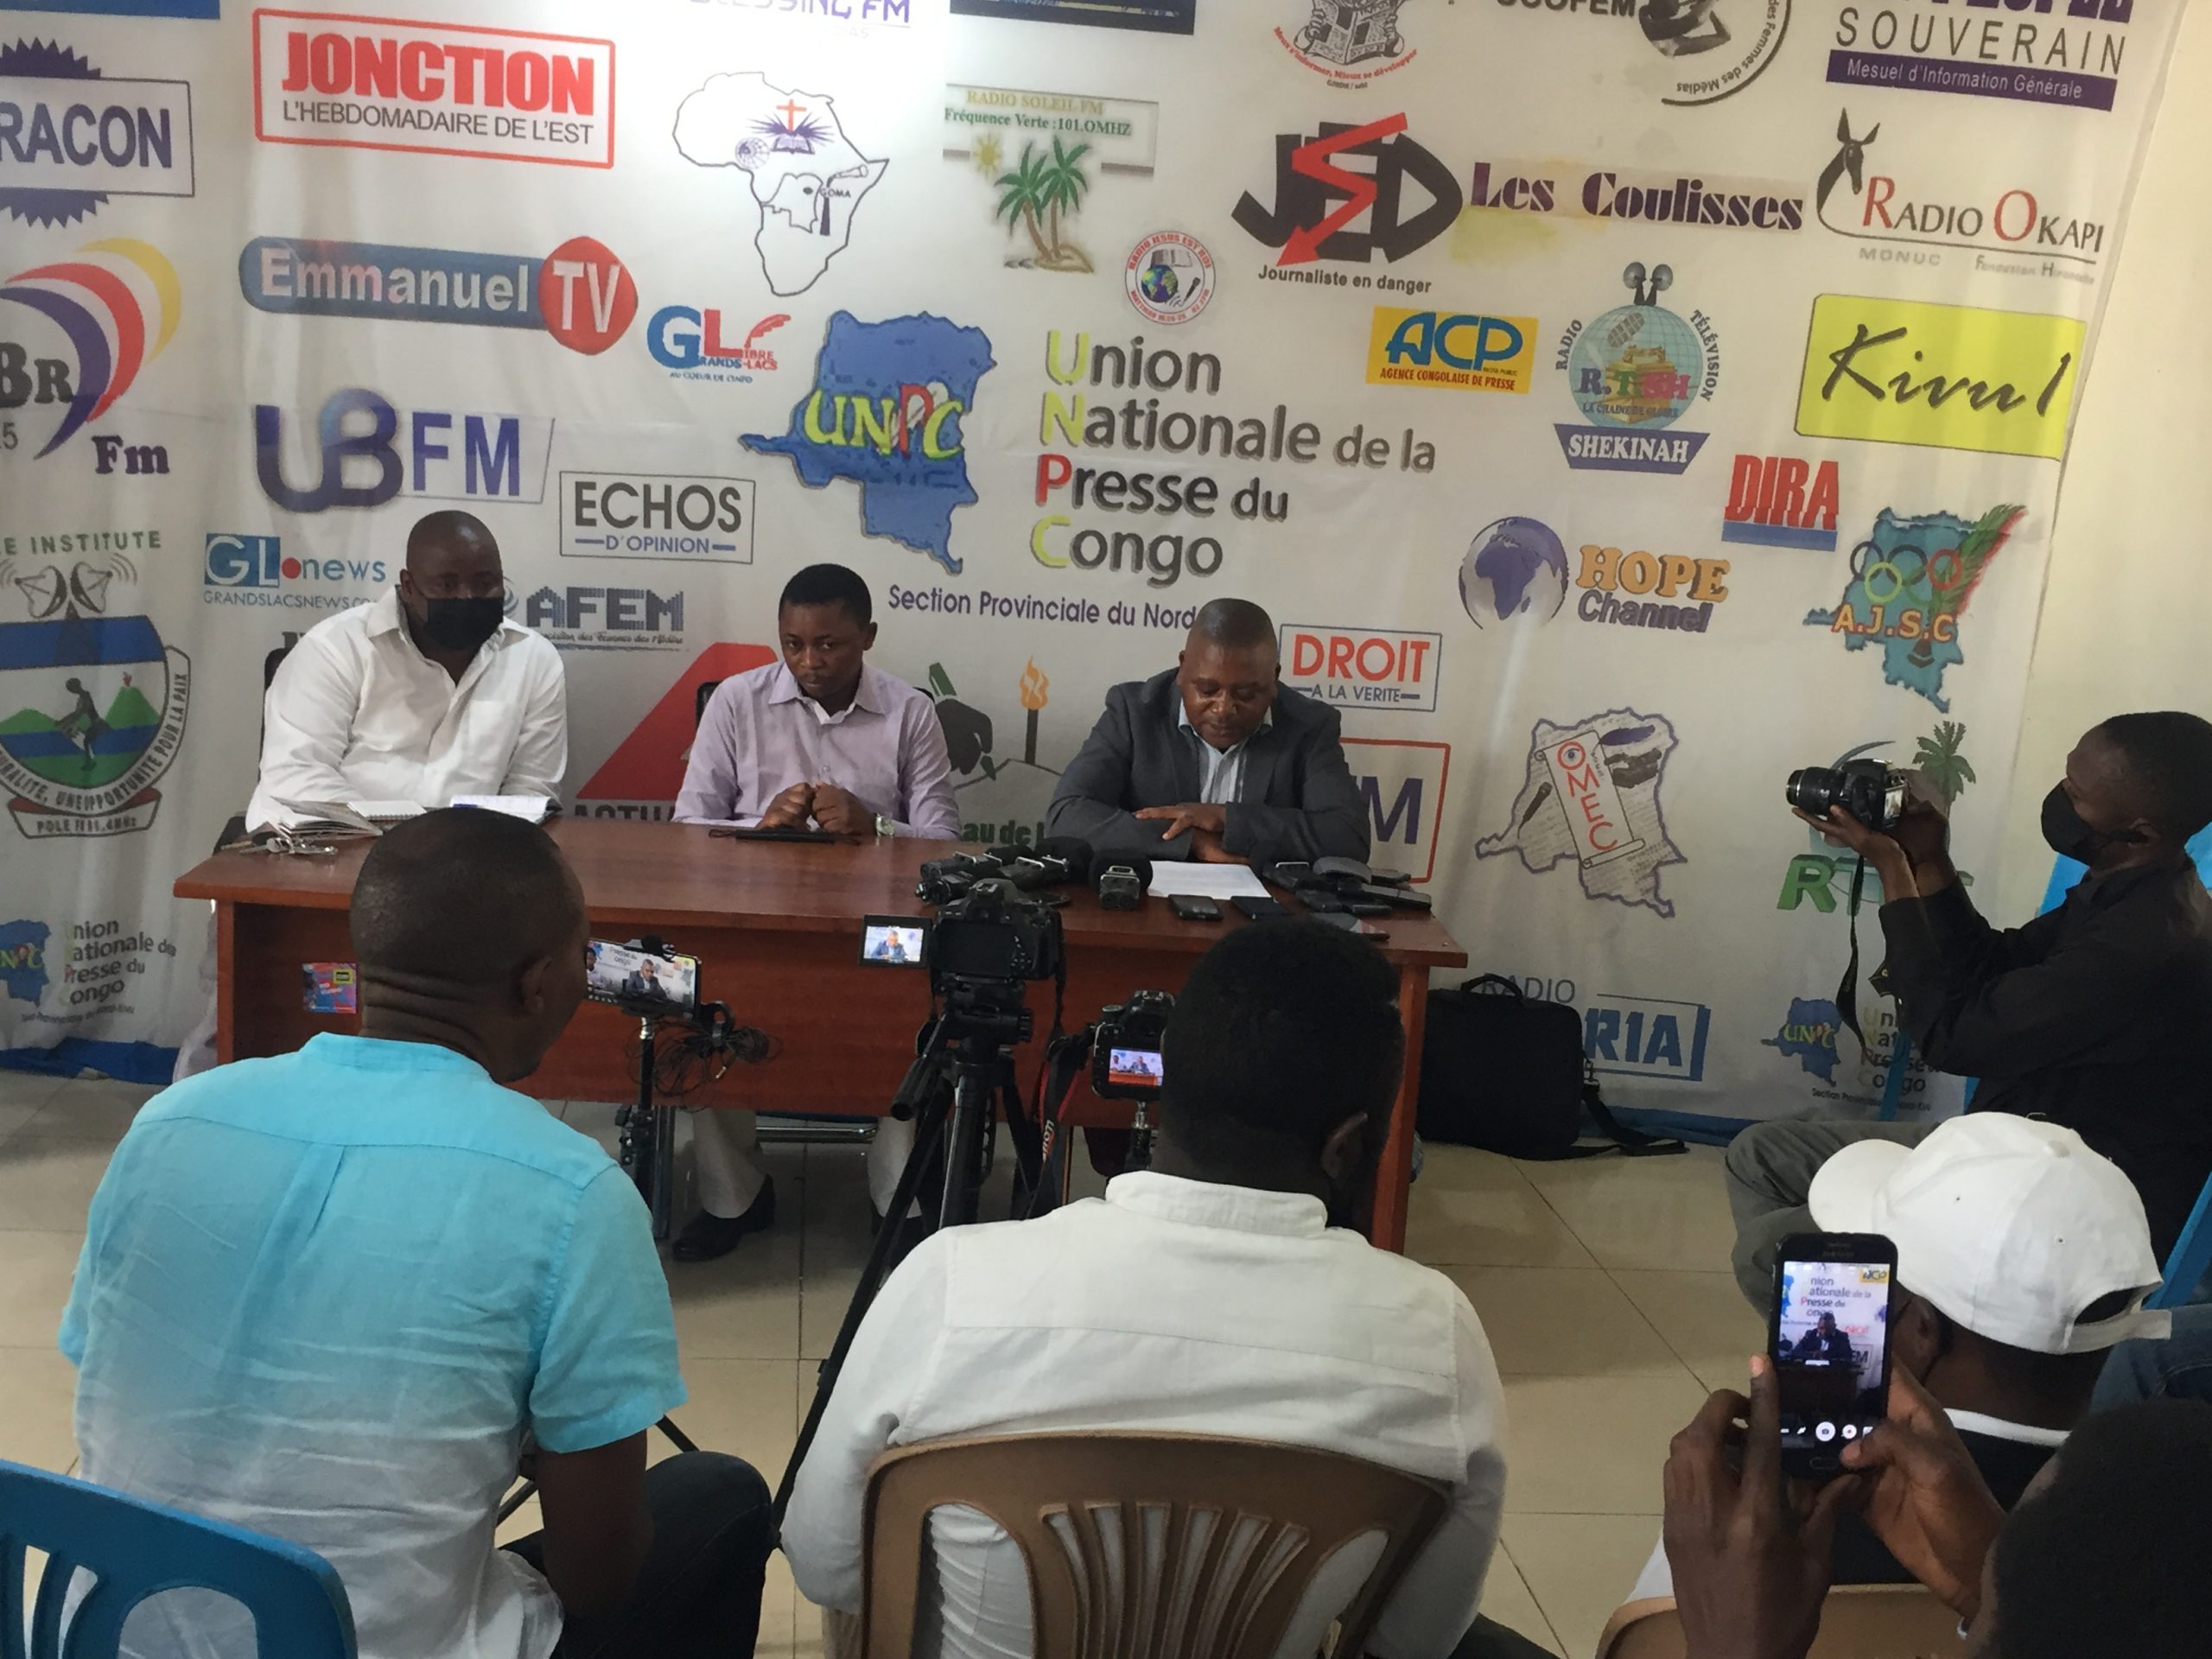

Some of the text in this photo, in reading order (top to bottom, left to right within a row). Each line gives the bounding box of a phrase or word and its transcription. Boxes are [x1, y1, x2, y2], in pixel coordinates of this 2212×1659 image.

[1741, 22, 1777, 68] Femmes
[1835, 7, 2126, 76] SOUVERAIN
[282, 32, 595, 116] JONCTION
[1676, 77, 1719, 95] Médias
[1721, 67, 1742, 84] des
[1847, 58, 2082, 99] Mesuel d'Information Générale
[283, 99, 594, 146] L'HEBDOMADAIRE DE L'EST
[944, 107, 1012, 125] Fréquence
[1014, 113, 1050, 129] Verte
[966, 90, 1104, 115] RADIO SOLEIL FM
[1471, 162, 1804, 231] Les Coulisses
[1861, 175, 2105, 253] RADIO OKAPI
[1258, 264, 1433, 296] Journaliste en danger
[1859, 247, 1942, 266] MONUC
[261, 247, 621, 334] Emmanuel TV
[1046, 329, 1222, 396] Union
[1384, 311, 1523, 372] ACP
[1555, 319, 1583, 371] RADIO
[1689, 308, 1720, 402] TÉLÉVISION
[1380, 367, 1516, 391] AGENCE CONGOLAISE DE PRESSE
[804, 383, 963, 460] UNPC
[1039, 391, 1435, 474] Nationale de la
[92, 435, 170, 474] Fm
[412, 410, 521, 497] FM
[1568, 433, 1689, 464] SHEKINAH
[574, 480, 742, 534] ECHOS
[1034, 452, 1290, 522] Presse du
[1724, 453, 1840, 531] DIRA
[30, 530, 162, 556] INSTITUTE
[605, 535, 710, 555] D'OPINION
[1030, 514, 1224, 588] Congo
[1575, 543, 1732, 602] HOPE
[526, 585, 684, 632] AFEM
[887, 583, 1198, 631] Section Provinciale du Nord
[1577, 588, 1715, 633] Channel
[1829, 603, 1957, 643] A.J.S.C
[1292, 633, 1431, 684] DROIT
[172, 673, 188, 709] PAIX
[1311, 685, 1402, 703] A LA VERITE
[169, 710, 185, 728] LA
[1557, 741, 1618, 851] OMEC
[126, 957, 146, 975] du
[1783, 1021, 1836, 1048] UNPC
[1858, 1067, 1927, 1096] Cogo
